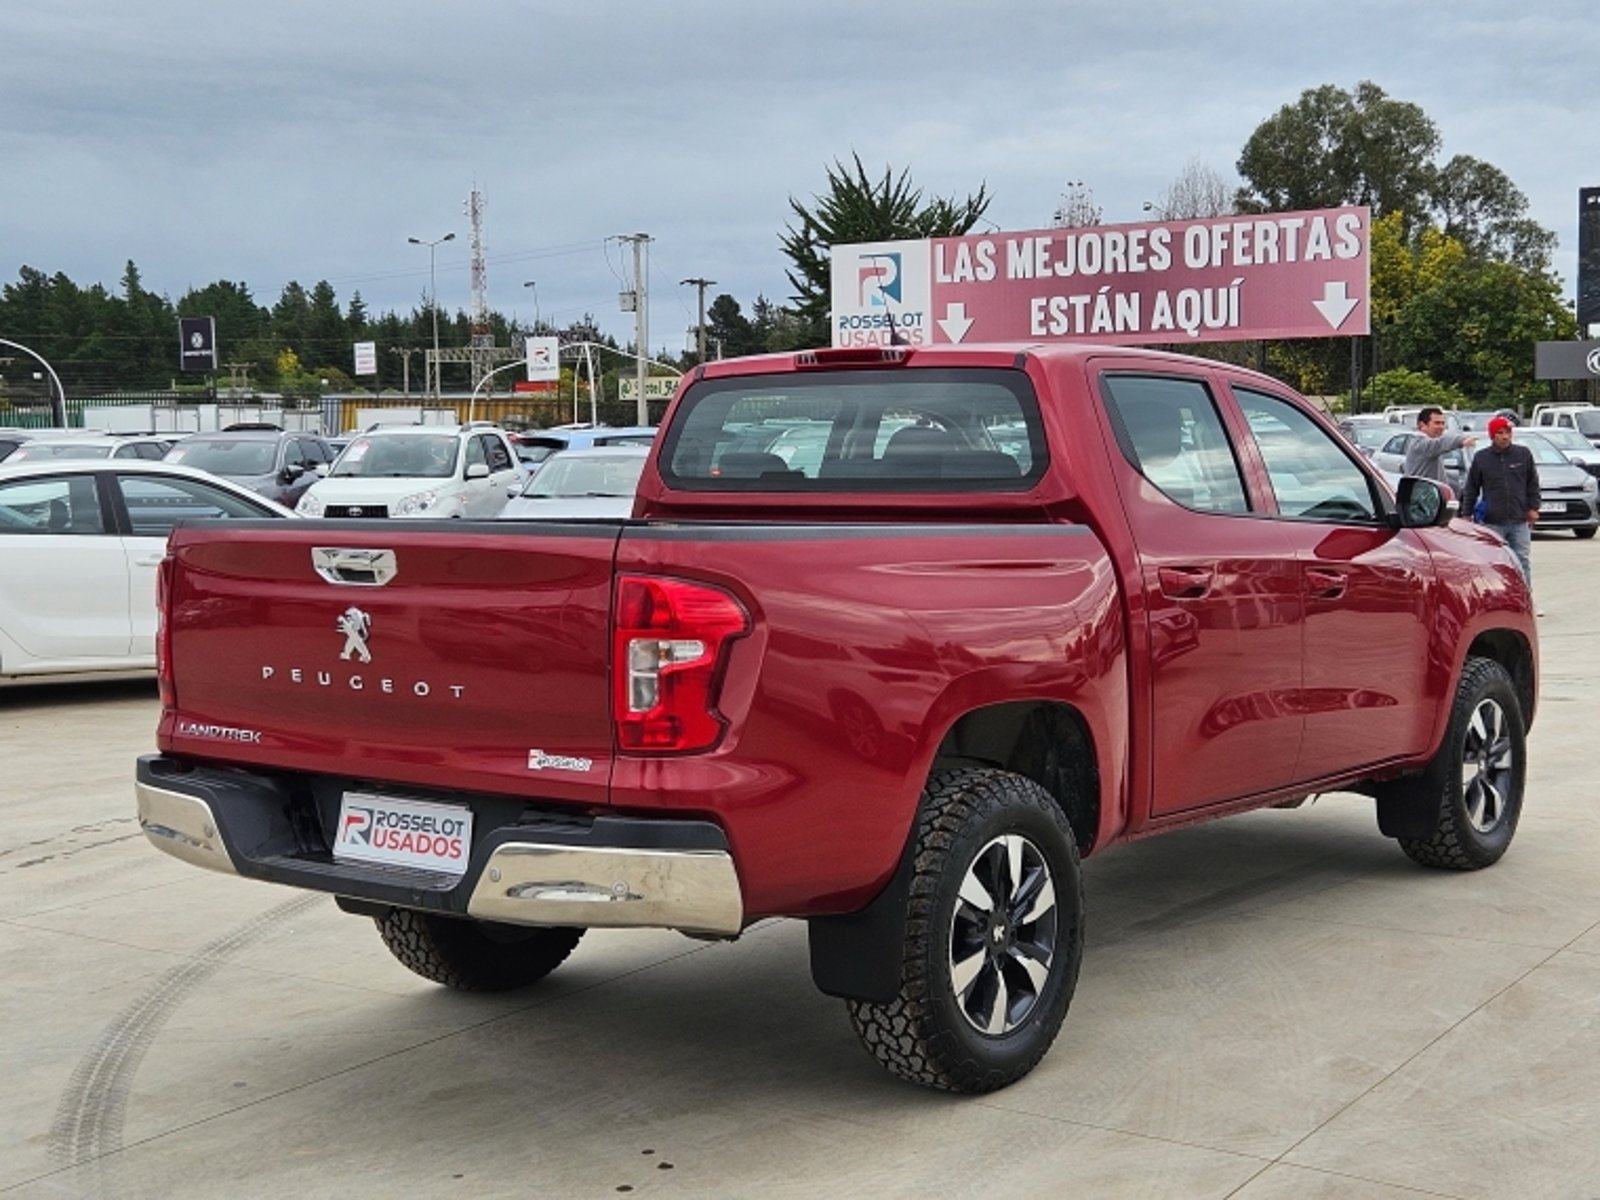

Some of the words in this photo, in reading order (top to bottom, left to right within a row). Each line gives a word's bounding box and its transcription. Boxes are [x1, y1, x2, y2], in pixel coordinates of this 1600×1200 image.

[935, 239, 997, 284] LAS
[1006, 227, 1172, 280] MEJORES
[1184, 213, 1361, 269] OFERTAS
[839, 312, 922, 330] ROSSELOT
[1031, 285, 1140, 336] ESTÁN
[1151, 277, 1245, 337] AQUÍ
[262, 666, 464, 698] PEUGEOT
[179, 722, 262, 744] LANDTREK
[376, 810, 464, 836] ROSSELOT
[373, 828, 462, 859] USADOS
